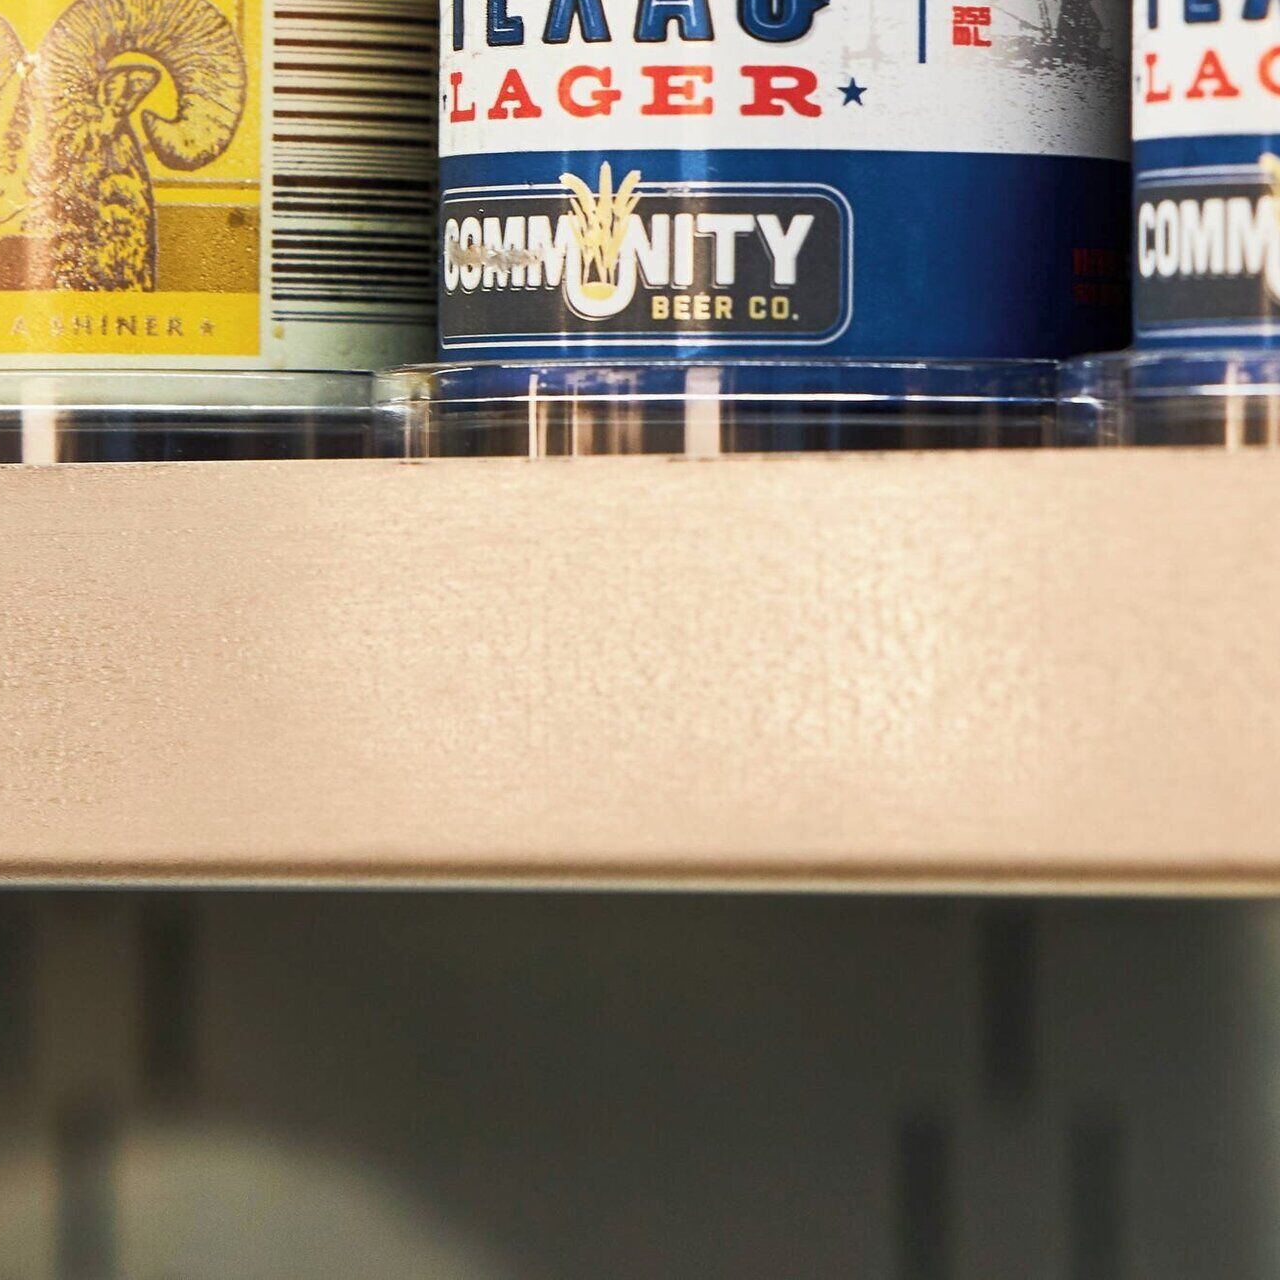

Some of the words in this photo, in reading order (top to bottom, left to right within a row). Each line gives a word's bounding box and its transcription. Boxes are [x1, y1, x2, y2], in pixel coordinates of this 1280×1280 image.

[449, 65, 823, 122] LAGER
[444, 213, 814, 318] COMMUNITY
[49, 315, 184, 338] SHINER
[652, 295, 733, 320] BEER
[749, 295, 799, 320] CO.
